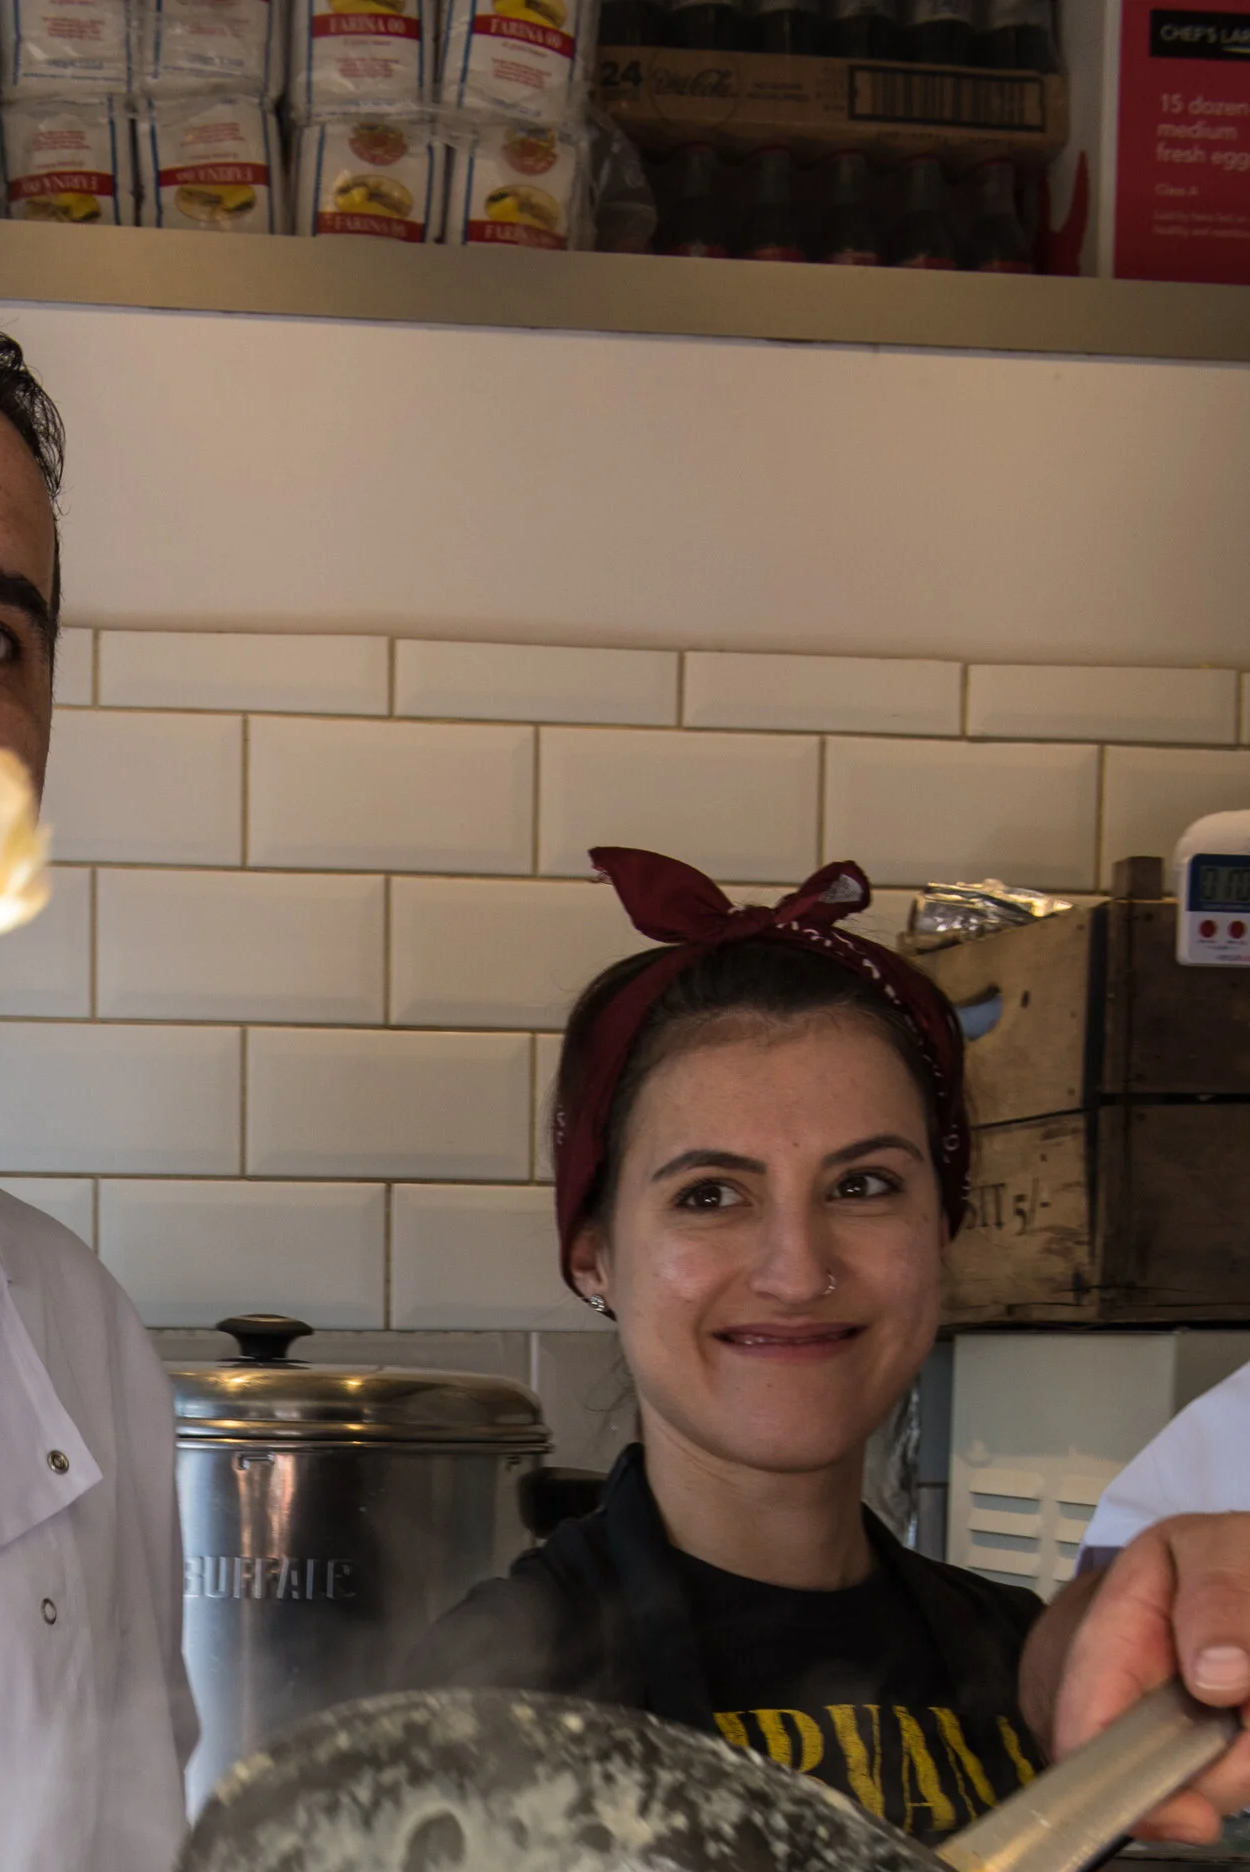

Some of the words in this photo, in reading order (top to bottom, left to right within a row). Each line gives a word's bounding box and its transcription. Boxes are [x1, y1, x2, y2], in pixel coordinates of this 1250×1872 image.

[329, 15, 386, 35] FARINA
[490, 18, 544, 44] FARINA
[601, 61, 644, 88] 24
[1161, 93, 1185, 115] 15
[1156, 120, 1238, 141] medium
[1155, 141, 1207, 163] fresh
